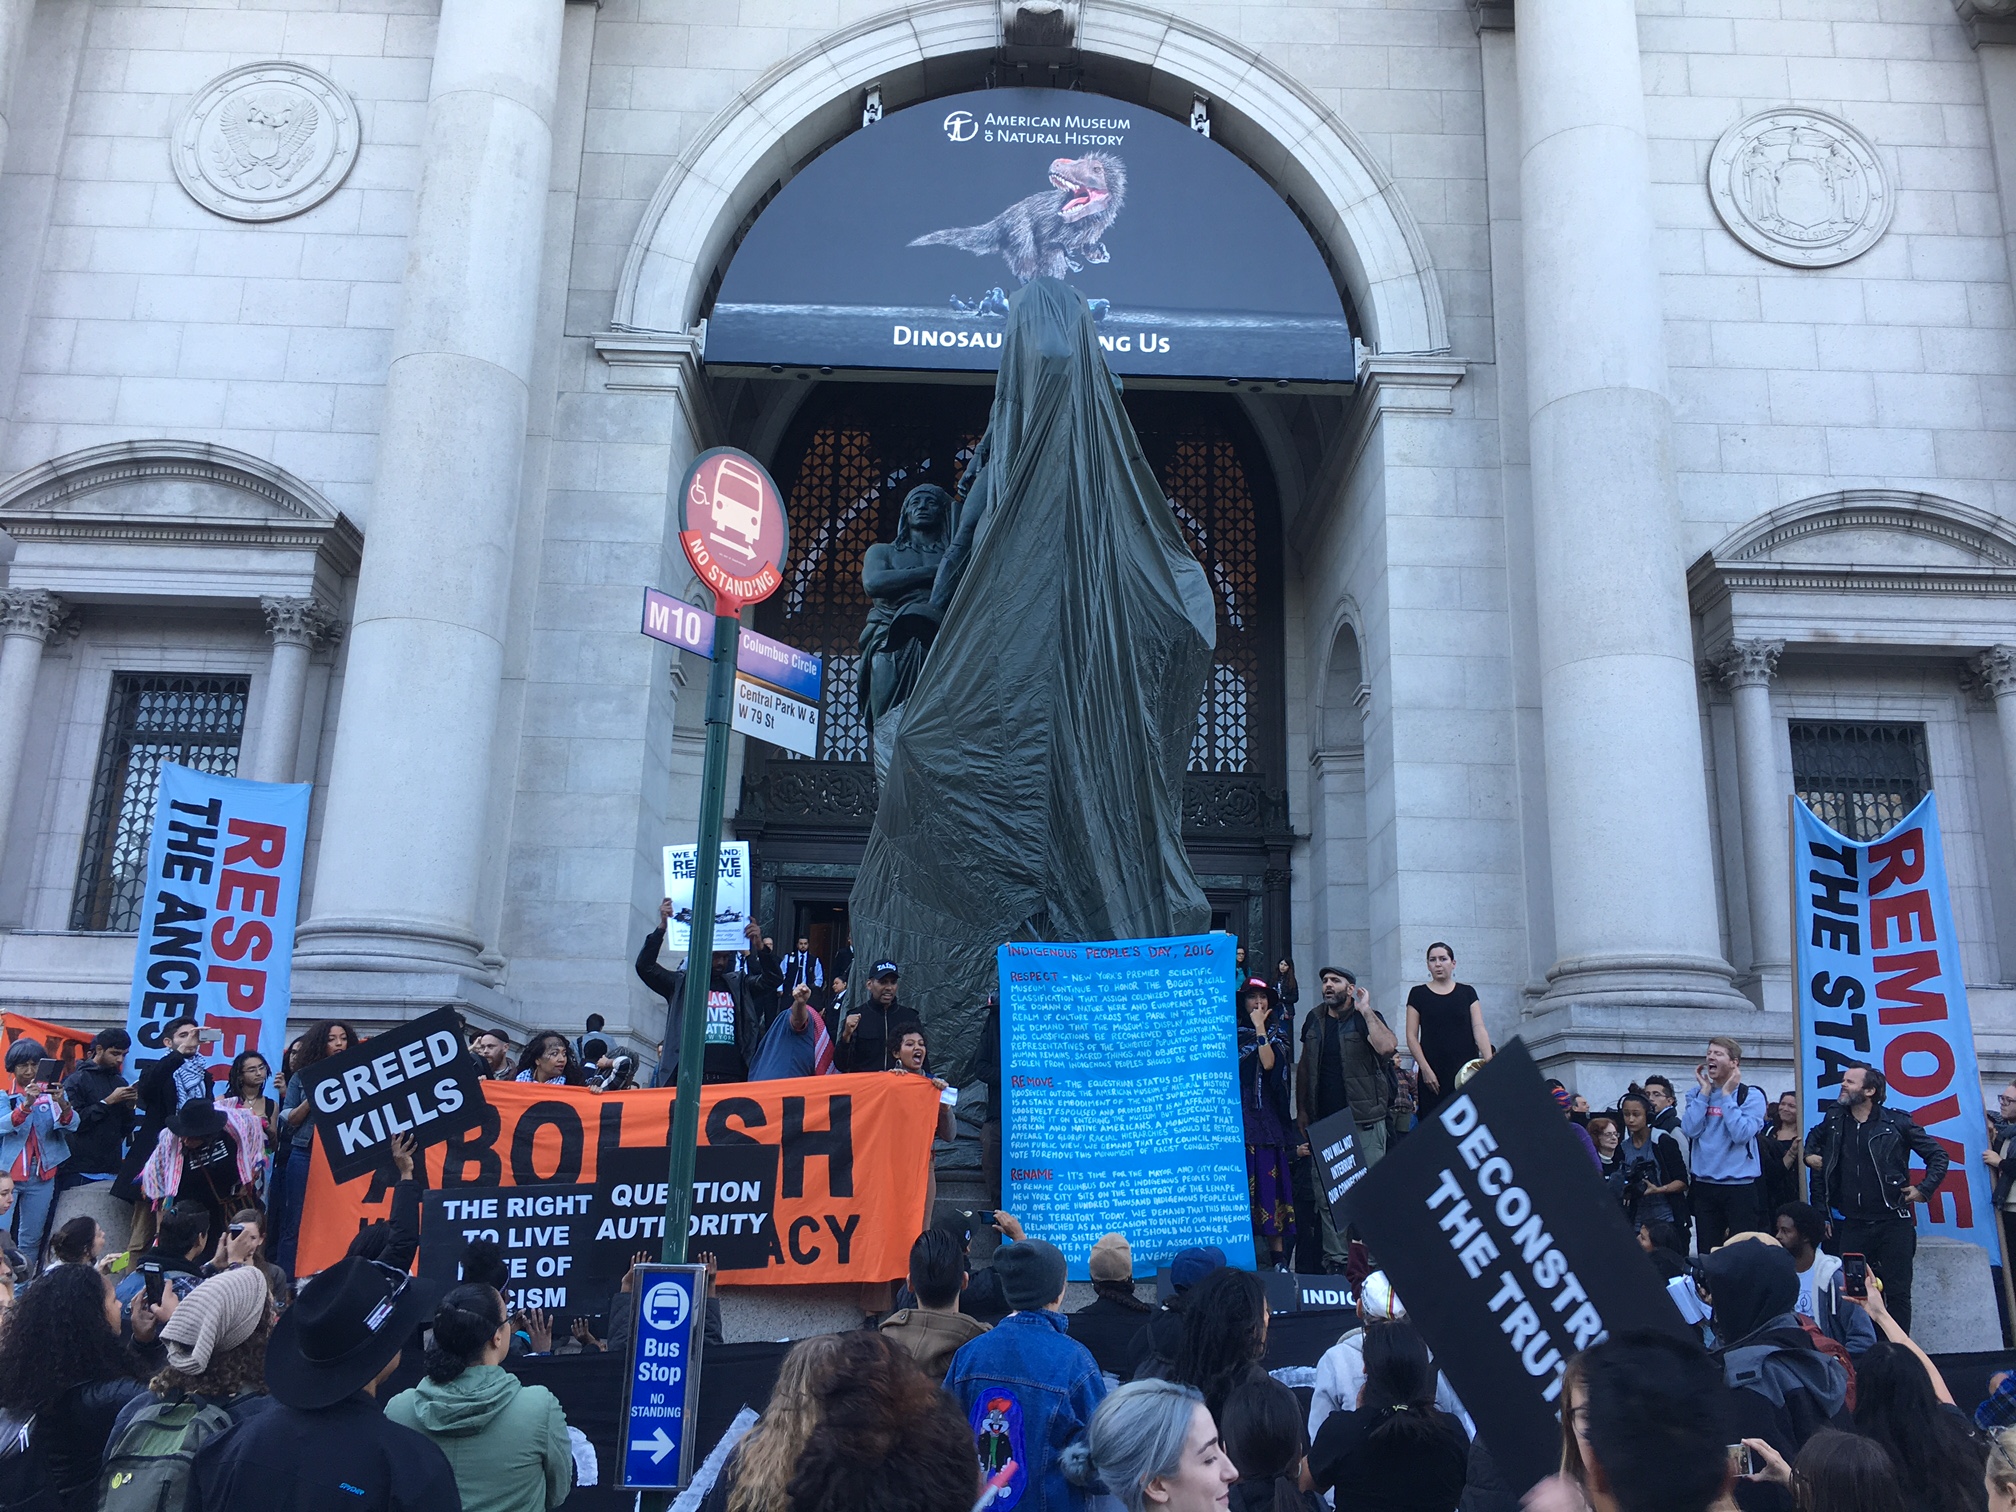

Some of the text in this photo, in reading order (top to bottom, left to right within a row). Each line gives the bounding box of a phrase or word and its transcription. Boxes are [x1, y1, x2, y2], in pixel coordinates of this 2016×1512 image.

[984, 112, 1130, 130] AMERICAN MUSEUM
[997, 130, 1061, 144] NATURAL
[1065, 131, 1124, 146] HISTORY
[1777, 224, 1837, 240] EXCELSIOR
[893, 325, 1002, 349] DINOSAU
[1140, 332, 1170, 353] US
[690, 538, 710, 566] NO
[708, 564, 775, 598] STANDING
[649, 600, 701, 645] M10
[743, 634, 817, 676] Columbus Circle
[740, 684, 815, 725] Central Park W &
[739, 702, 775, 729] W 79 St
[162, 798, 222, 885] THE
[674, 858, 741, 870] REVE
[672, 871, 696, 879] THE
[1008, 944, 1214, 959] INDIGENOUS PEOPLE'S DAY, 2016
[1010, 967, 1212, 982] RESPECT NEW YORK'S PREMIER SCIENTIFIC
[1011, 985, 1046, 993] MUSEUM
[1052, 985, 1091, 993] CONTINUE
[1114, 982, 1139, 991] HONOR
[1144, 981, 1161, 990] THE
[1166, 979, 1193, 989] BOGUS
[1199, 976, 1225, 986] RACIAL
[1809, 842, 1871, 1131] THE STA
[1011, 994, 1073, 1002] CLASSIFICATION
[1102, 994, 1127, 1002] ASSIGN
[1132, 991, 1169, 1001] COLONIZED
[1174, 989, 1204, 998] PEOPLES
[707, 1007, 734, 1023] IVES
[1012, 1013, 1039, 1021] REALM
[1095, 1013, 1121, 1021] ACROSS
[1125, 1013, 1140, 1021] THE
[1146, 1012, 1166, 1020] PARK
[1199, 1006, 1218, 1015] MET
[706, 1024, 734, 1035] ATTER
[1867, 827, 1974, 1228] REMOVE
[314, 1030, 459, 1113] GREED
[1010, 1060, 1040, 1068] STOLEN
[1069, 1061, 1111, 1069] INDIGENOUS
[1115, 1060, 1143, 1068] PEOPLES
[1147, 1058, 1172, 1066] SHOULD
[1011, 1072, 1233, 1088] REMOVE THE EQUESTRIAN STATUS OF THEODORE
[336, 1078, 464, 1156] KILLS
[1166, 1115, 1210, 1128] MONUMENT
[1213, 1116, 1234, 1124] THAT
[1010, 1150, 1028, 1159] VOTE
[1042, 1151, 1073, 1159] REMOVE
[1095, 1149, 1135, 1157] MONUMENT
[1154, 1145, 1179, 1153] RACIST
[1321, 1134, 1354, 1163] YOU WILL NOT
[1011, 1168, 1053, 1181] RENAME
[1068, 1171, 1084, 1180] IT'S
[1149, 1169, 1173, 1177] MAYOR
[1330, 1154, 1356, 1180] INTERRUPT
[1024, 1183, 1053, 1191] RENAME
[1059, 1183, 1096, 1191] COLUMBUS
[1120, 1179, 1130, 1187] AS
[1135, 1176, 1179, 1187] INDIGENOUS
[1183, 1175, 1210, 1183] PEOPLES
[612, 1181, 761, 1207] QUETION
[1054, 1193, 1072, 1201] CITY
[1130, 1186, 1173, 1196] TERRITORY
[1177, 1185, 1187, 1193] OF
[1189, 1184, 1203, 1192] THE
[1206, 1184, 1235, 1192] LENAPE
[1328, 1187, 1340, 1204] OUR
[443, 1195, 592, 1220] THE RIGHT
[1425, 1169, 1499, 1279] THE
[1439, 1095, 1609, 1351] DECONSTR
[508, 1226, 569, 1247] LIVE
[536, 1256, 572, 1277] OF
[506, 1287, 566, 1309] CISM
[644, 1338, 679, 1357] Bus
[638, 1362, 681, 1386] Stop
[651, 1394, 664, 1405] NO
[631, 1406, 681, 1418] STANDING
